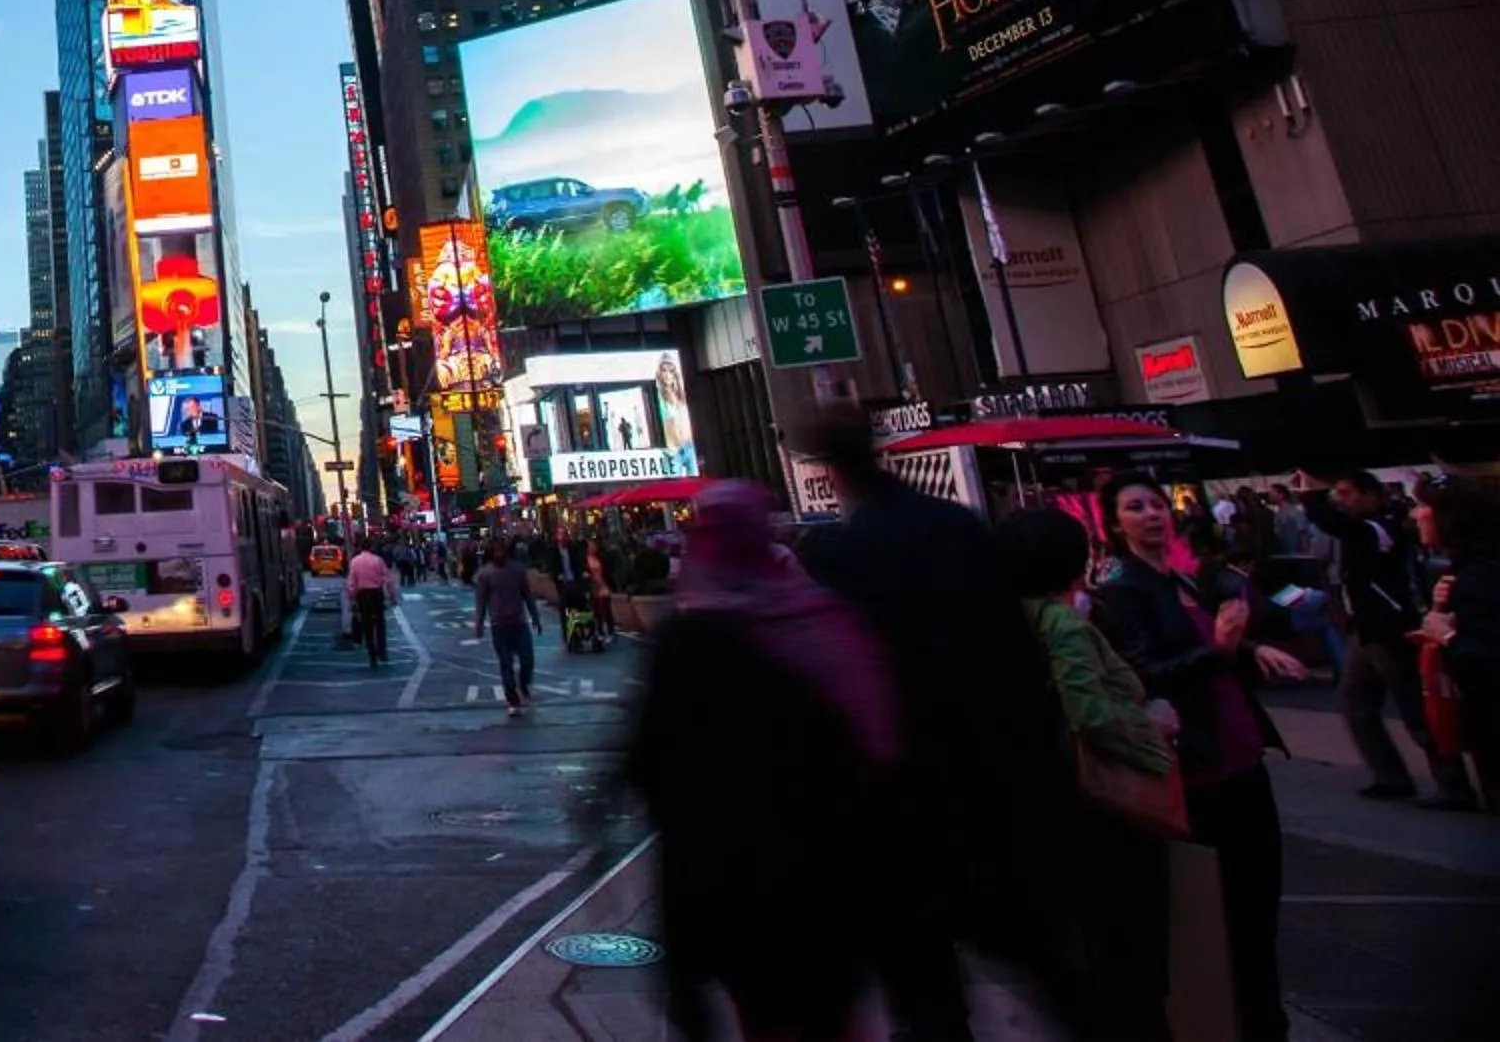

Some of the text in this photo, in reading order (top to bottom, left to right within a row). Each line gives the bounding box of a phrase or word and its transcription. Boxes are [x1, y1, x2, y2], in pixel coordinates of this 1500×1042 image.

[966, 6, 1055, 62] DECEMBER 13
[143, 88, 187, 106] TDK
[771, 309, 847, 333] W 45 St
[902, 401, 932, 430] DOGS
[566, 455, 677, 479] AÉROPOSTALE
